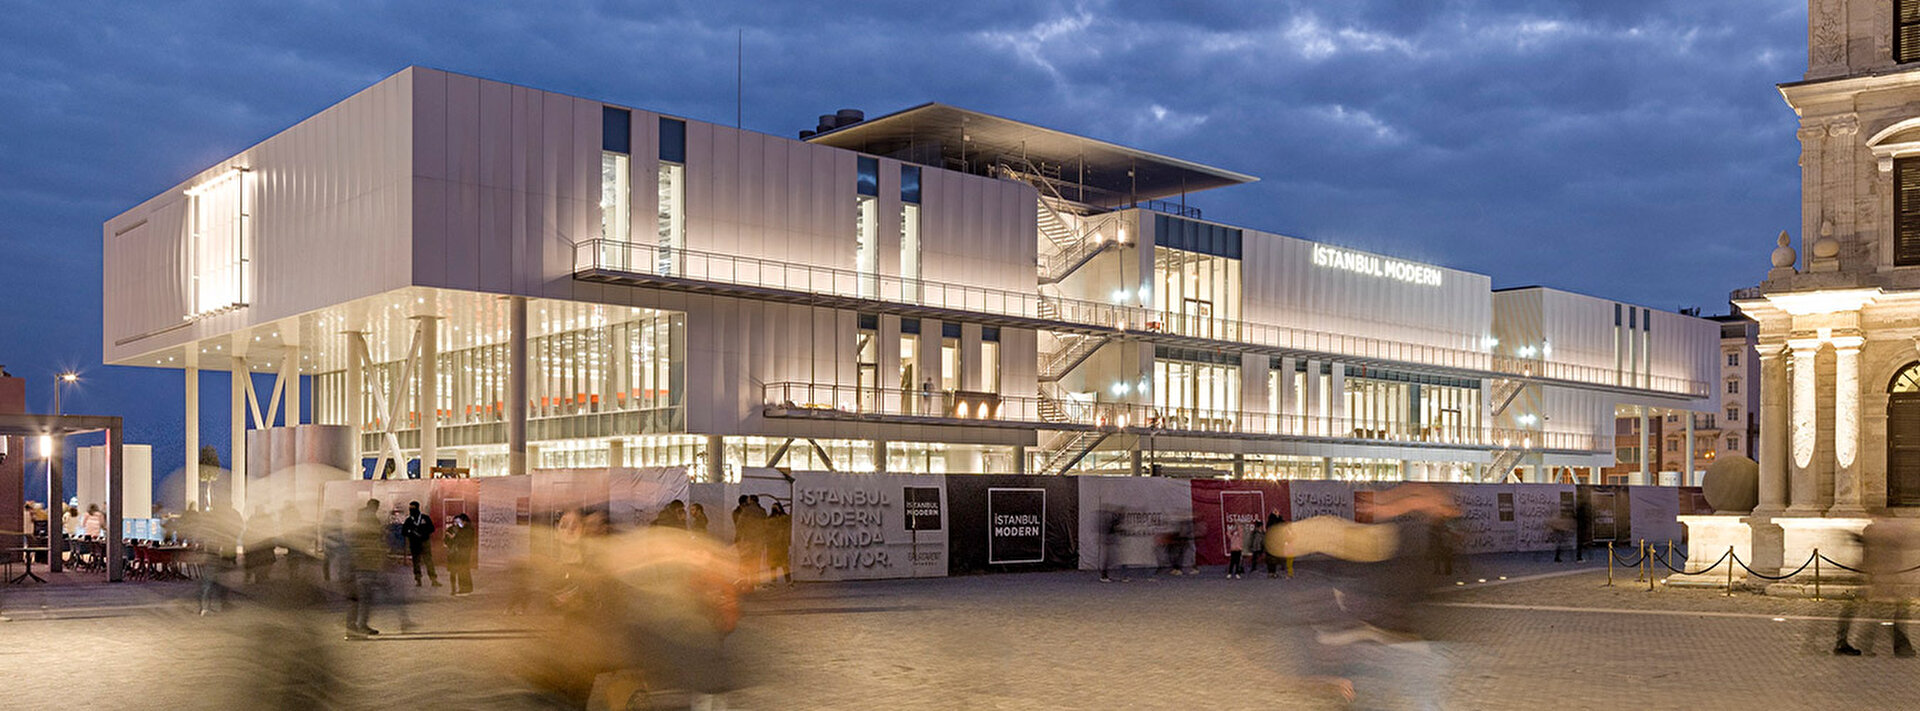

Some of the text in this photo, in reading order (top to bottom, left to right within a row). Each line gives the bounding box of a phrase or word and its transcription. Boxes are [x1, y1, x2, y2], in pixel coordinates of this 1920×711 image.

[1385, 260, 1442, 286] MODERN
[800, 488, 891, 507] İSTANBUL
[800, 509, 883, 528] MODERN
[994, 513, 1041, 525] İSTANBUL
[801, 530, 885, 548] YAKINDA
[995, 526, 1040, 537] MODERN
[800, 551, 893, 574] AÇILIYOR.
